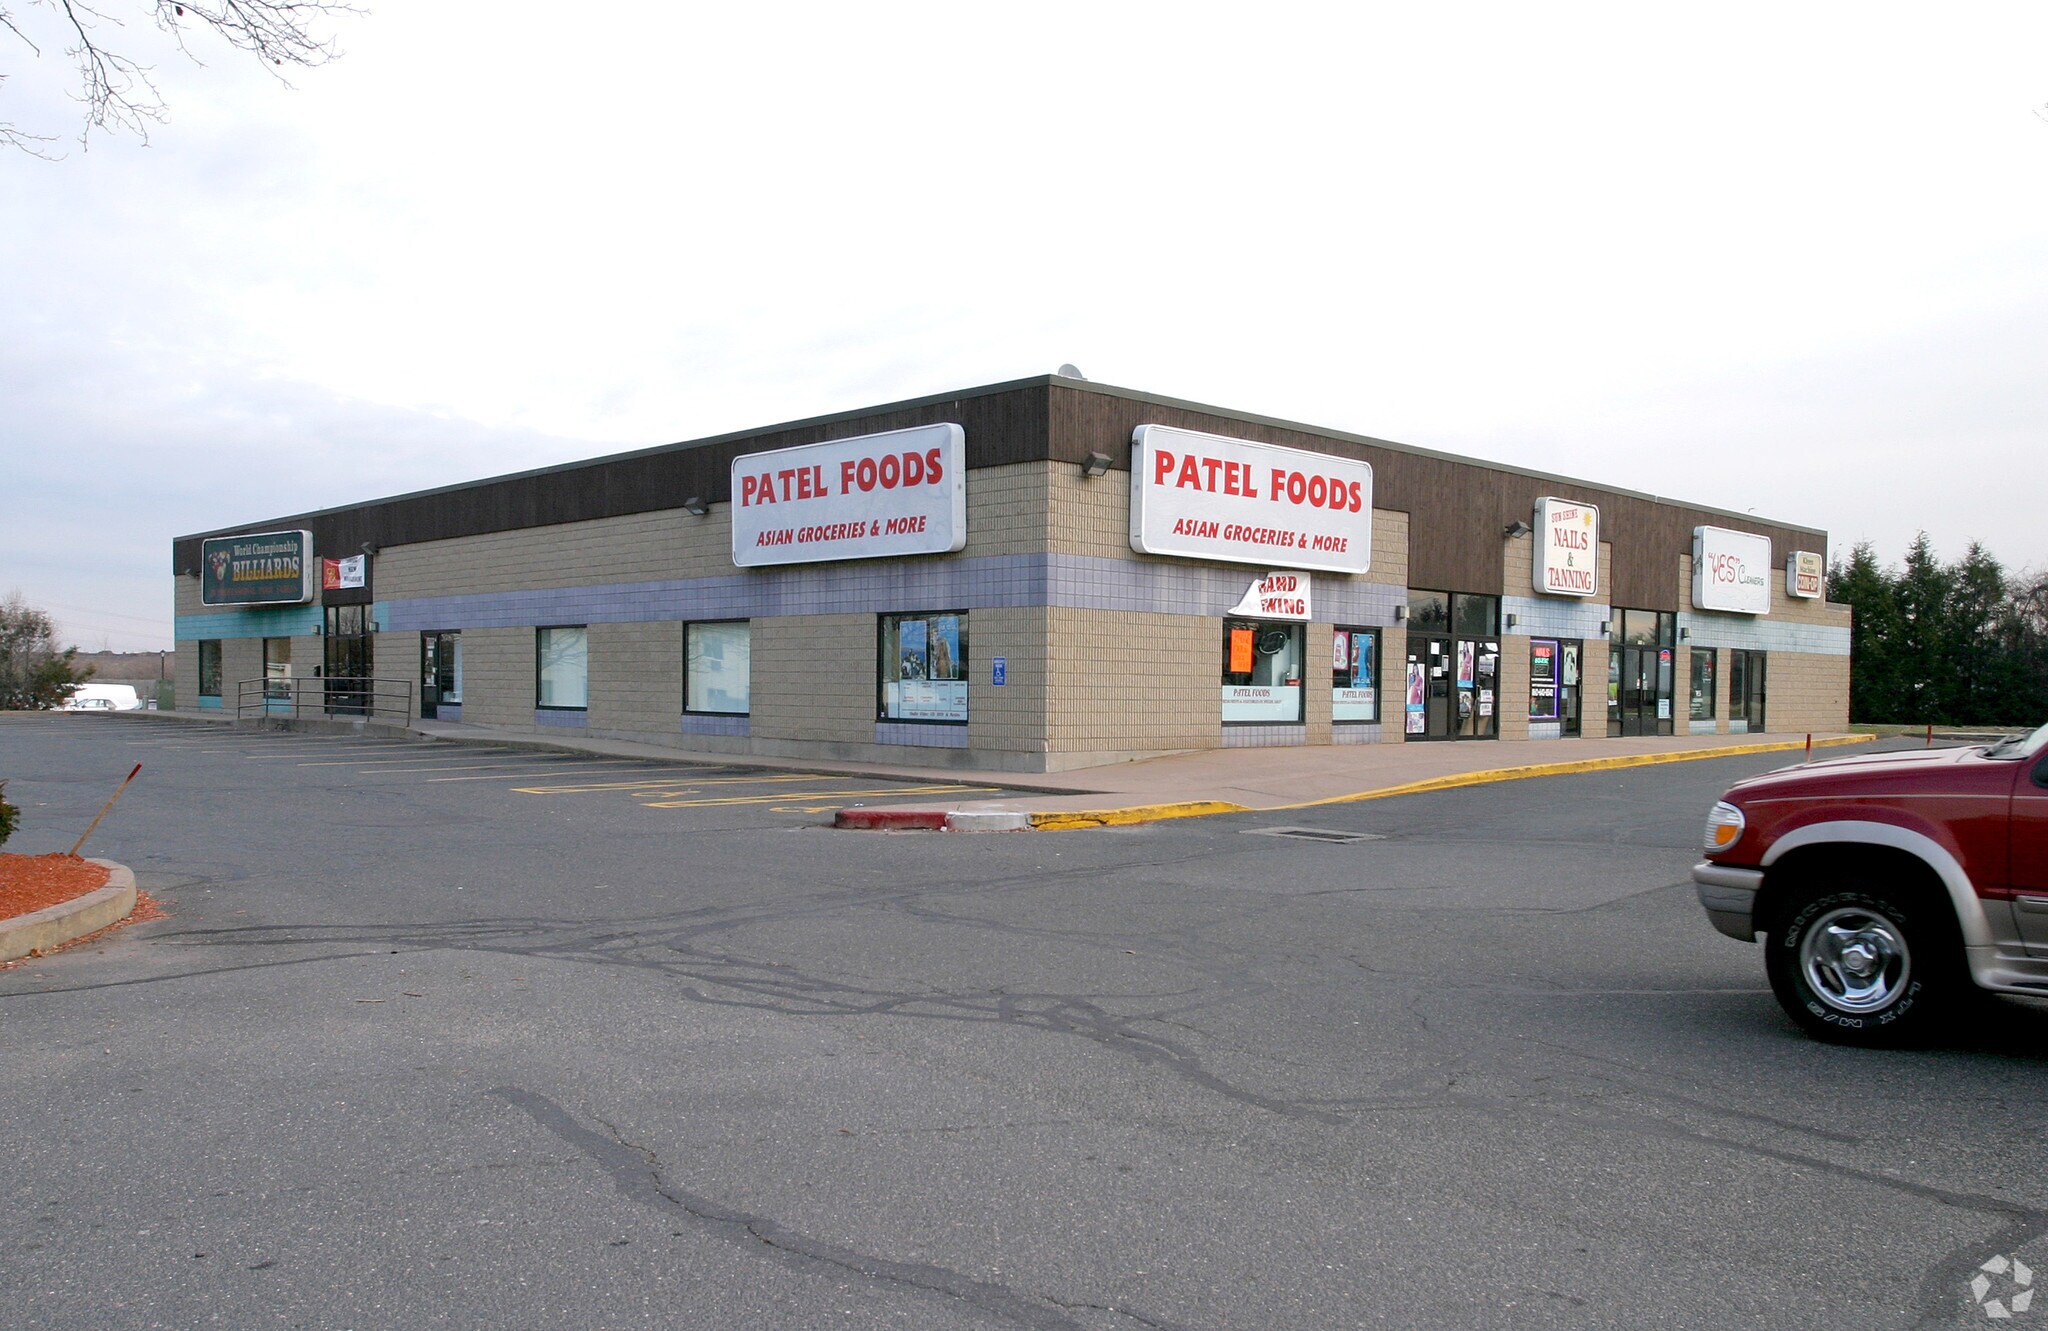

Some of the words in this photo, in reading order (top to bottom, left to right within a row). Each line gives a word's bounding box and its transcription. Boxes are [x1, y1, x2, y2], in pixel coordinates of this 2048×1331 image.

[741, 464, 829, 507] PATEL
[840, 447, 944, 495] FOODS
[1154, 449, 1259, 499] PATEL
[1270, 468, 1362, 514] FOODS
[756, 528, 794, 547] ASIAN
[797, 520, 866, 544] GROCERIES
[870, 519, 880, 537] &
[885, 515, 927, 536] MORE
[1172, 518, 1220, 539] ASIAN
[1224, 524, 1296, 548] GROCERIES
[1298, 533, 1307, 549] &
[1312, 535, 1348, 553] MORE
[1554, 528, 1588, 550] NAILS
[233, 544, 252, 556] World
[252, 540, 298, 556] Championship
[1567, 551, 1574, 567] &
[232, 557, 299, 581] BILLIARDS
[1548, 567, 1592, 589] TANNING
[1233, 688, 1251, 697] PATEL
[1252, 688, 1271, 698] FOODS
